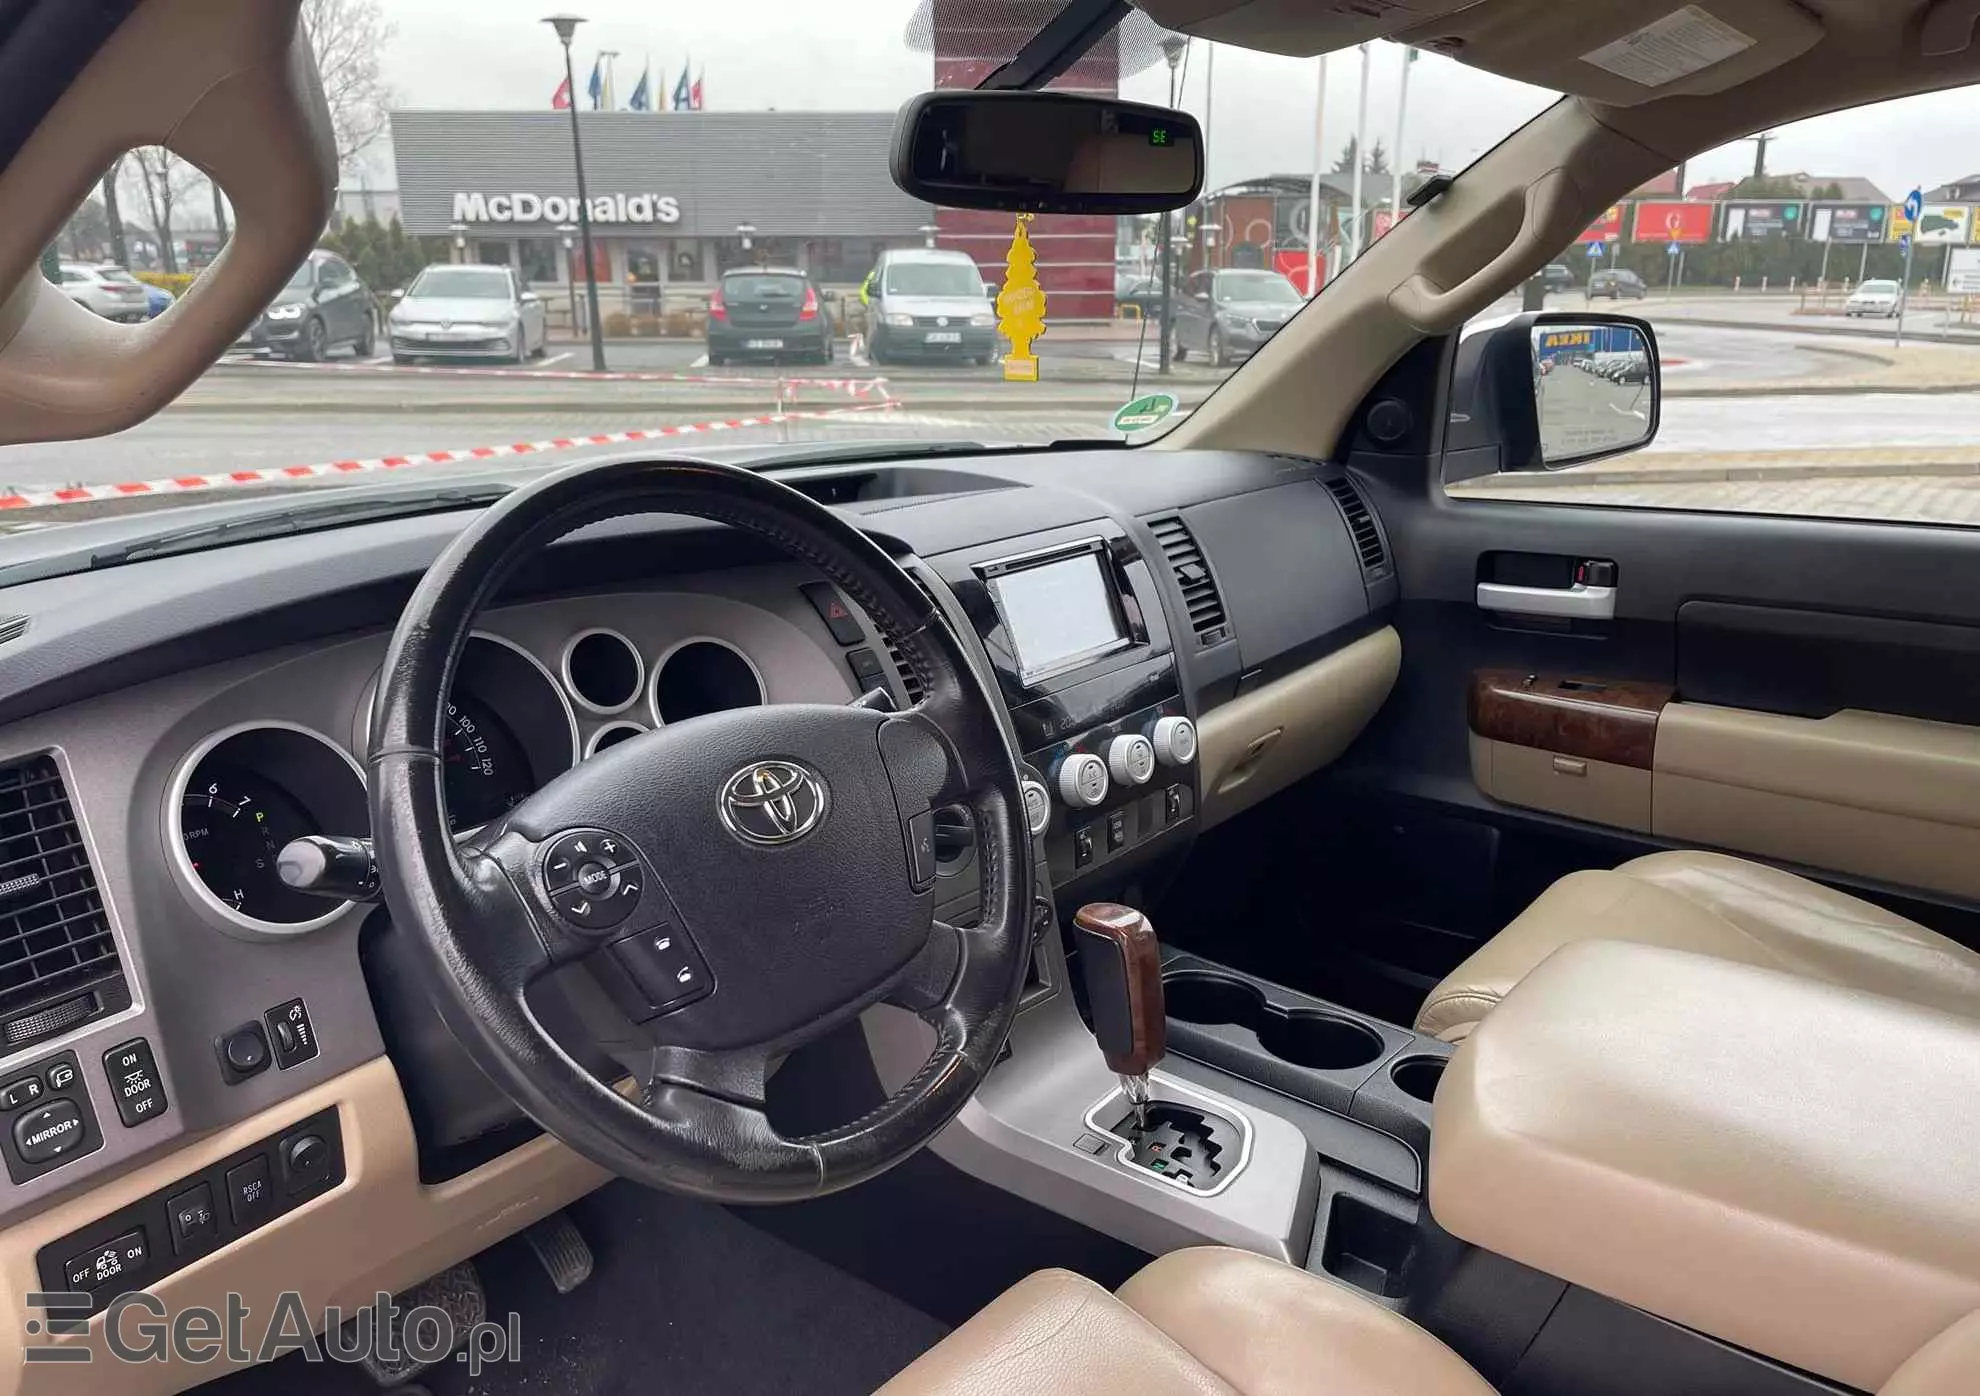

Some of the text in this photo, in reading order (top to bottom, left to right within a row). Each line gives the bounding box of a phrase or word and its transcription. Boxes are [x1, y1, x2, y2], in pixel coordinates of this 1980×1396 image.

[1152, 129, 1167, 144] SE
[452, 192, 681, 223] McDonald's
[459, 715, 476, 733] 100
[473, 736, 488, 753] 110
[481, 758, 494, 776] 120
[208, 783, 218, 794] 6
[239, 795, 252, 806] 7
[255, 811, 264, 822] P
[583, 870, 608, 885] MODE
[233, 889, 245, 900] H
[122, 1053, 137, 1067] ON
[28, 1084, 39, 1096] R
[124, 1078, 151, 1097] DOOR
[9, 1094, 18, 1105] L
[136, 1098, 153, 1113] OFF
[32, 1120, 73, 1145] MIRROR
[243, 1180, 262, 1196] RSCA
[127, 1247, 142, 1259] ON
[72, 1267, 91, 1283] OFF
[96, 1263, 122, 1281] DOOR
